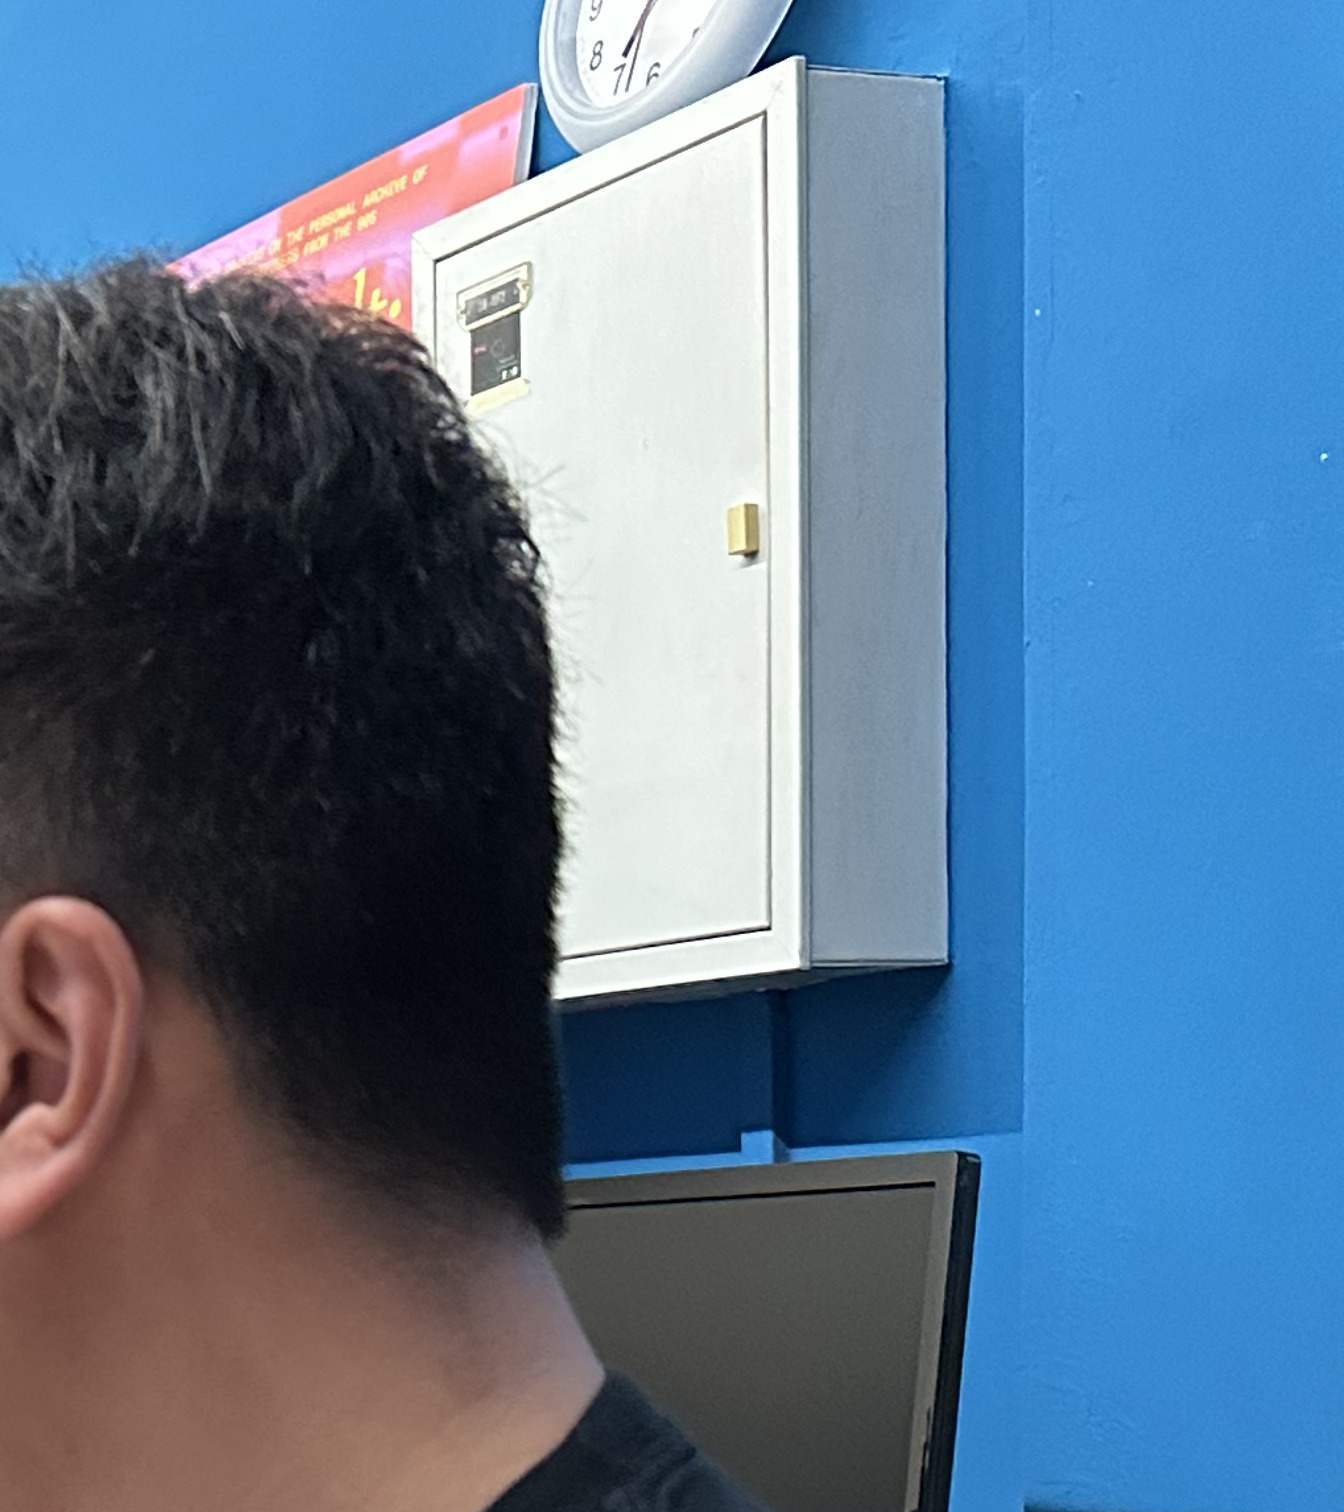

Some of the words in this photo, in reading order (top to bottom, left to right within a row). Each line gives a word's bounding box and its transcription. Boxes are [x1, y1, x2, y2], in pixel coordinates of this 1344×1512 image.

[590, 40, 604, 71] 8
[613, 63, 627, 96] 7
[287, 226, 305, 245] THE
[309, 201, 356, 233] PERSONAL
[363, 174, 408, 208] ARCHIVE
[412, 164, 429, 185] OF
[303, 233, 329, 256] FROM
[334, 221, 352, 242] THE
